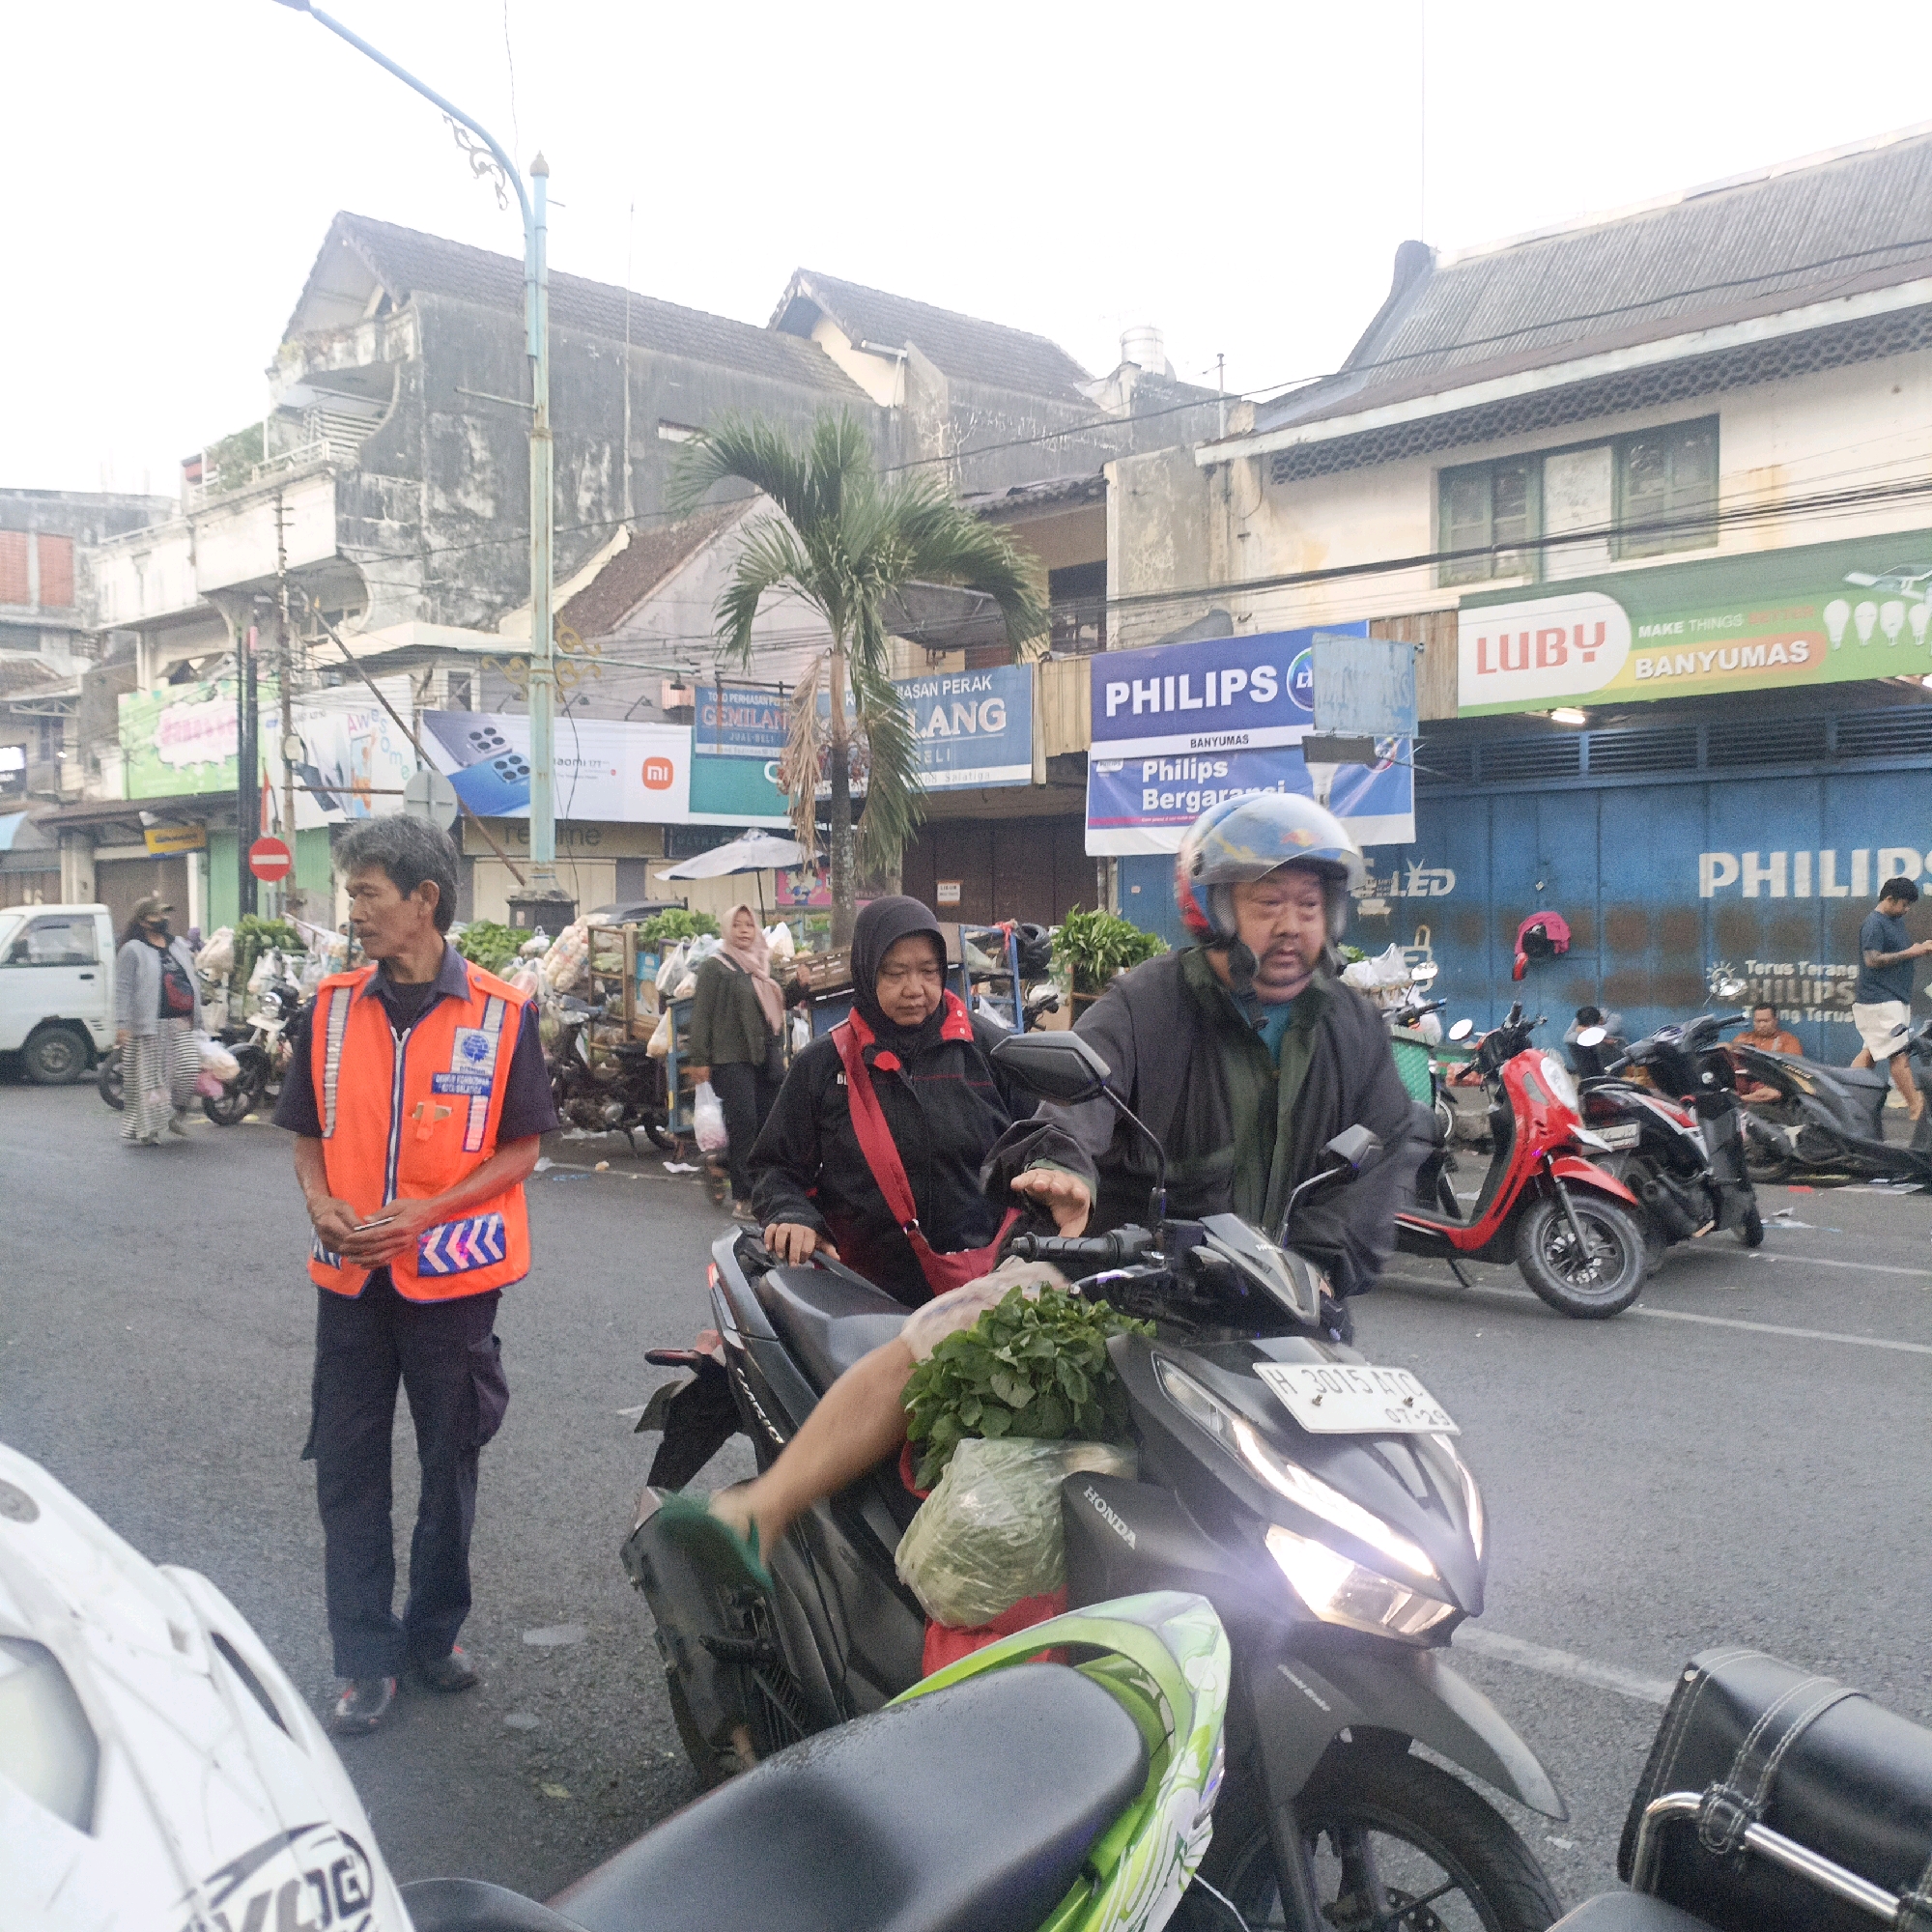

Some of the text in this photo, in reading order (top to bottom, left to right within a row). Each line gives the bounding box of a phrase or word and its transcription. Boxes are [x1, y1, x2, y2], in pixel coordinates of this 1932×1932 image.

[1638, 620, 1684, 639] MAKE
[1689, 613, 1744, 633] THINGS
[1477, 620, 1606, 675] LUBY
[1635, 639, 1810, 680] BANYUMAS
[708, 691, 728, 702] TOO
[942, 674, 992, 696] PERAK
[1106, 666, 1278, 717] PHILIPS
[701, 704, 787, 730] GEMILAN
[1190, 734, 1249, 749] BANYUMAS
[554, 757, 585, 767] iaomi
[1142, 757, 1229, 784] Philips
[504, 826, 601, 846] reme
[1698, 847, 1932, 897] PHILIP
[1745, 959, 1859, 980] Terus Terang
[1741, 979, 1856, 1005] HILIPS
[1805, 1007, 1855, 1023] Terus
[1265, 1368, 1424, 1397] H 3015 ATC
[1083, 1485, 1137, 1549] HONDA
